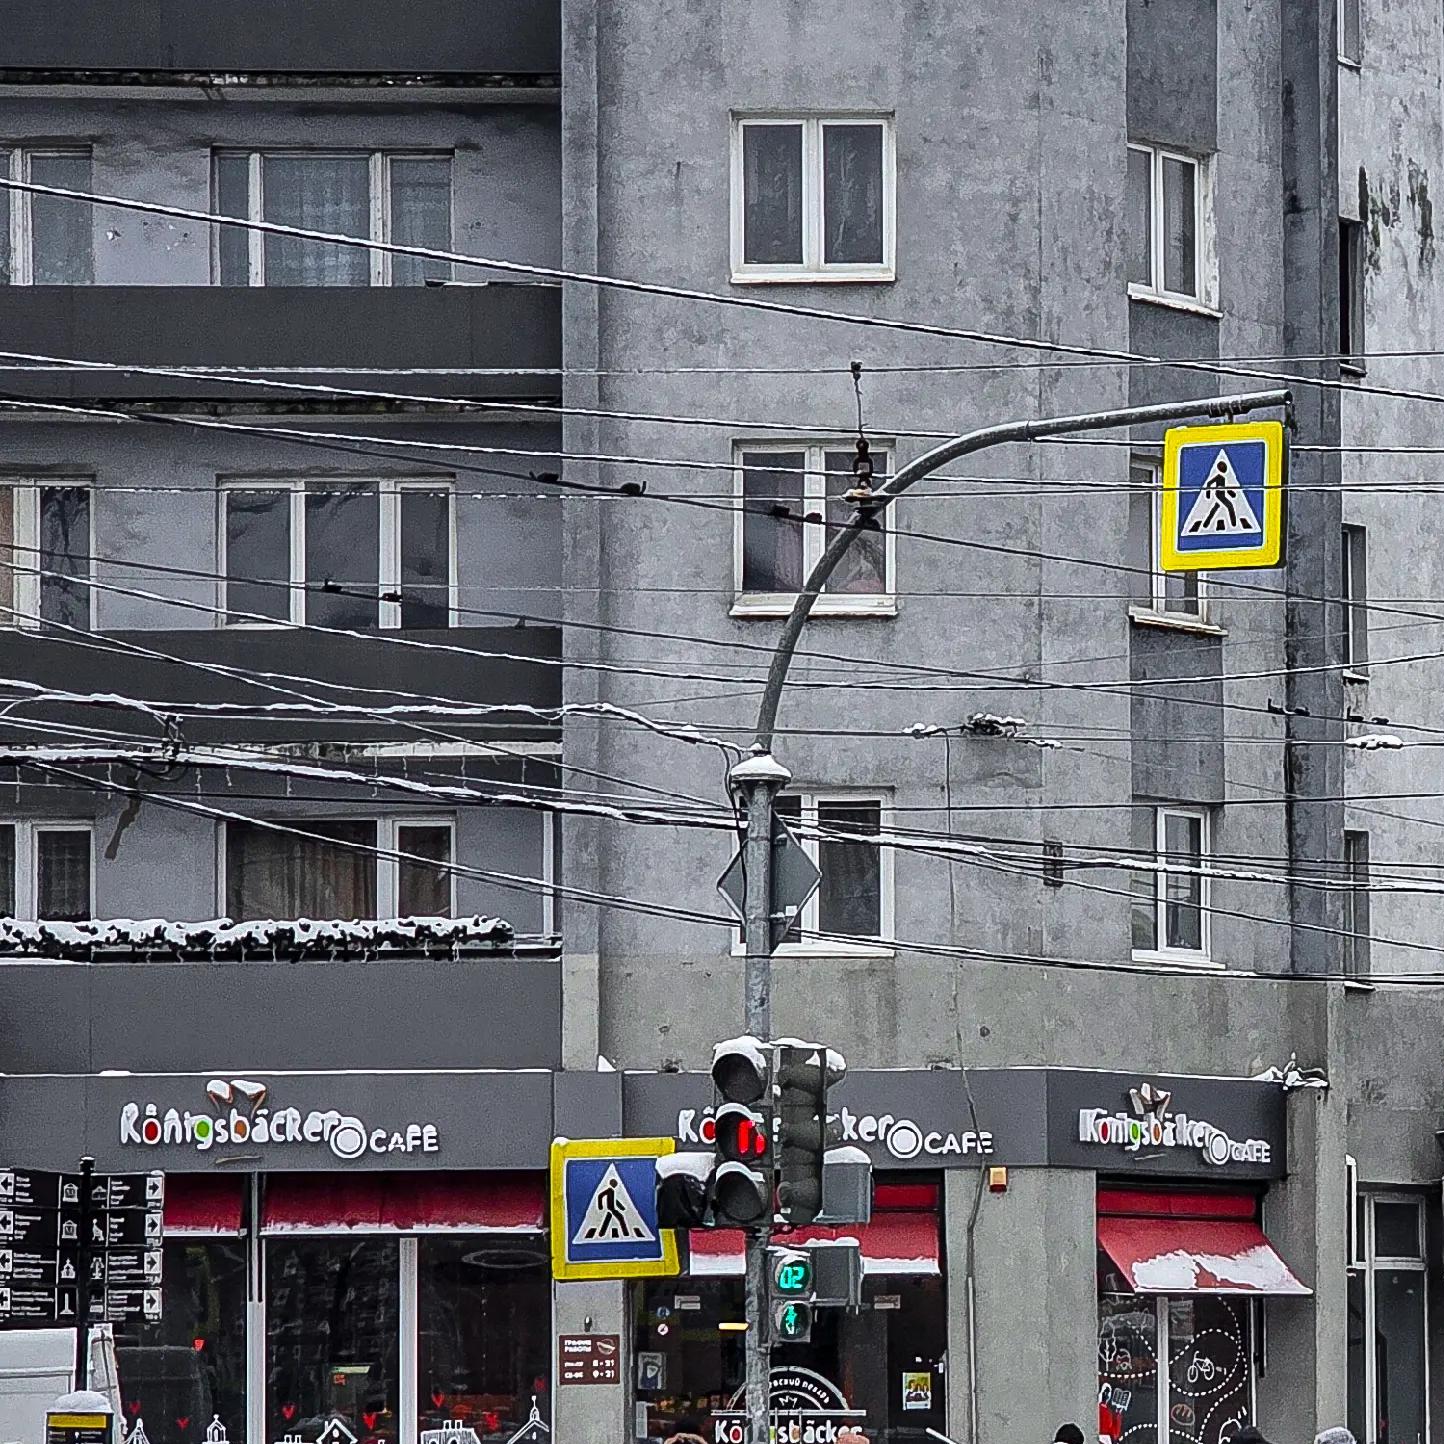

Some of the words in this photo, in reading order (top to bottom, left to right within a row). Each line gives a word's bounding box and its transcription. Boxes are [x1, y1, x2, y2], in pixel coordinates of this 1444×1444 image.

[370, 1124, 439, 1152] CAFE
[924, 1131, 994, 1154] CAFE
[780, 1266, 805, 1289] 02
